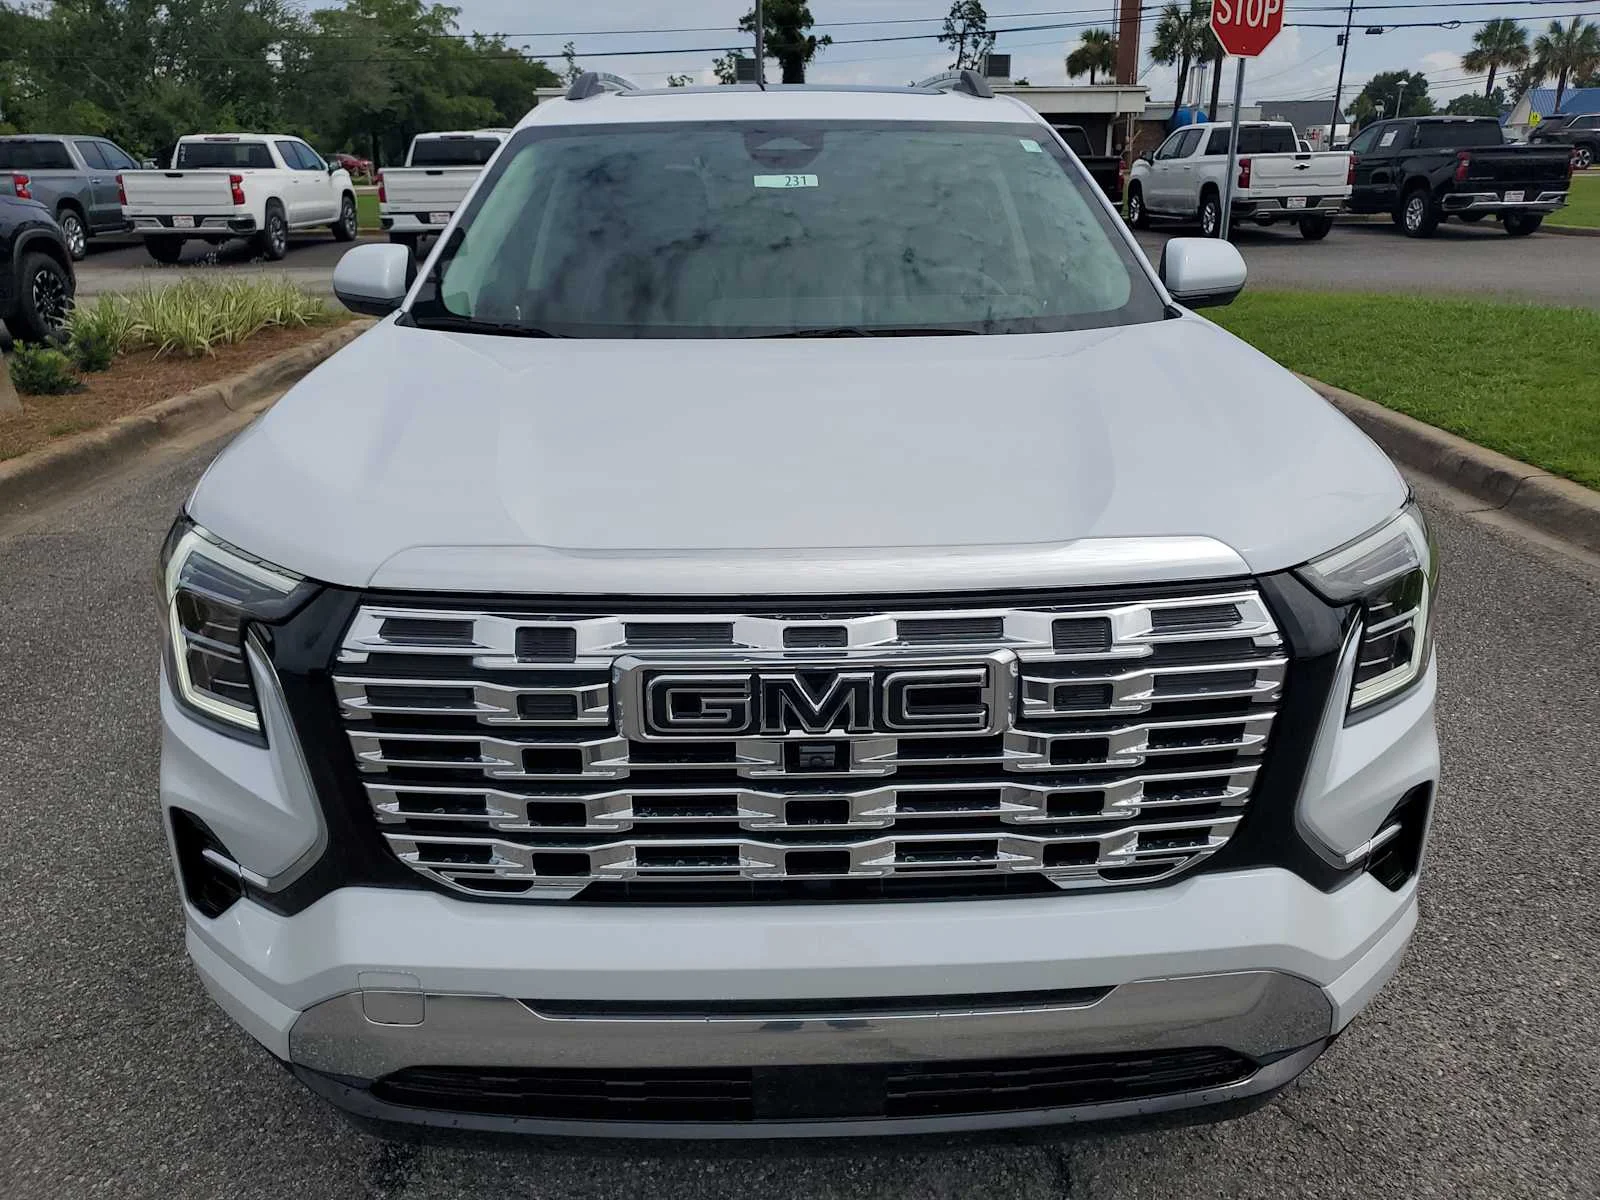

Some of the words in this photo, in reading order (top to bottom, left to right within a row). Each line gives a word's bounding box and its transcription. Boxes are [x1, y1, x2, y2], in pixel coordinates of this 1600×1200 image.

[1216, 0, 1281, 28] STOP
[784, 175, 806, 187] 231
[646, 668, 988, 734] GMC
